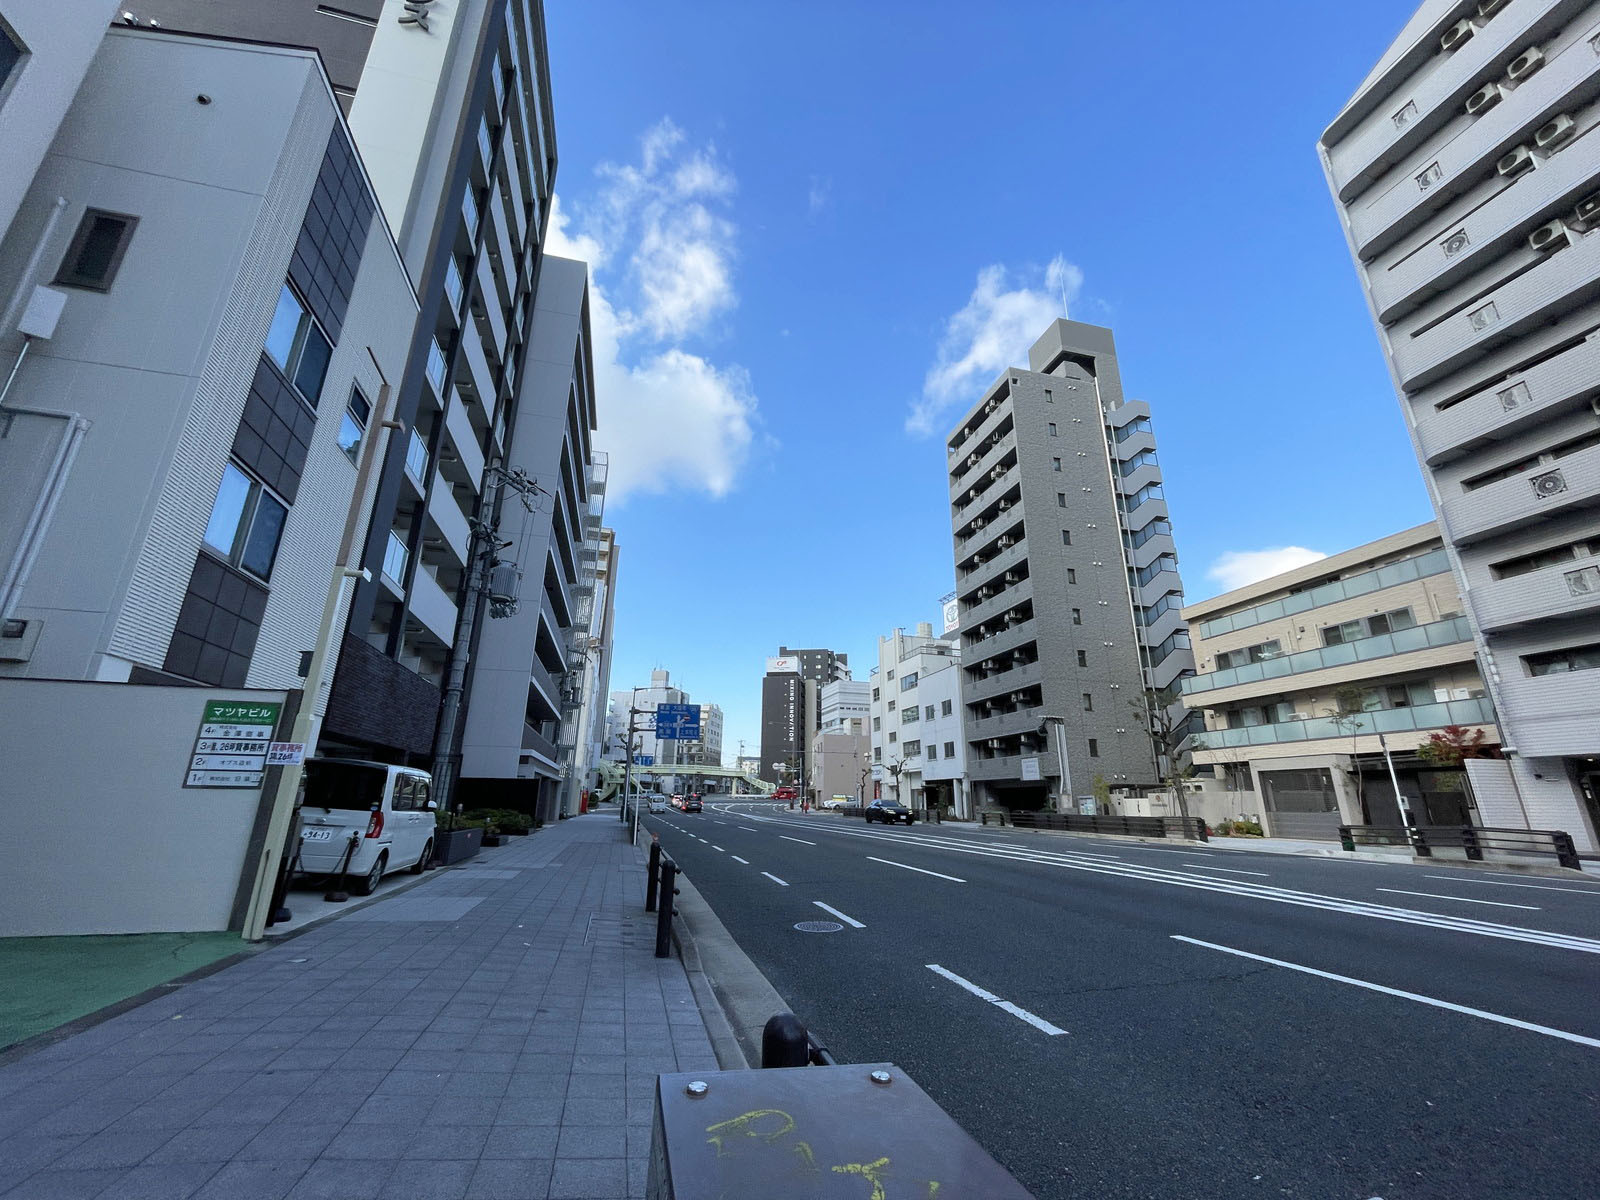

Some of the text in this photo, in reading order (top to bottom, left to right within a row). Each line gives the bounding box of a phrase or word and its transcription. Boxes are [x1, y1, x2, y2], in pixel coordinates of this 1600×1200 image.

[213, 707, 271, 717] マツヤビル
